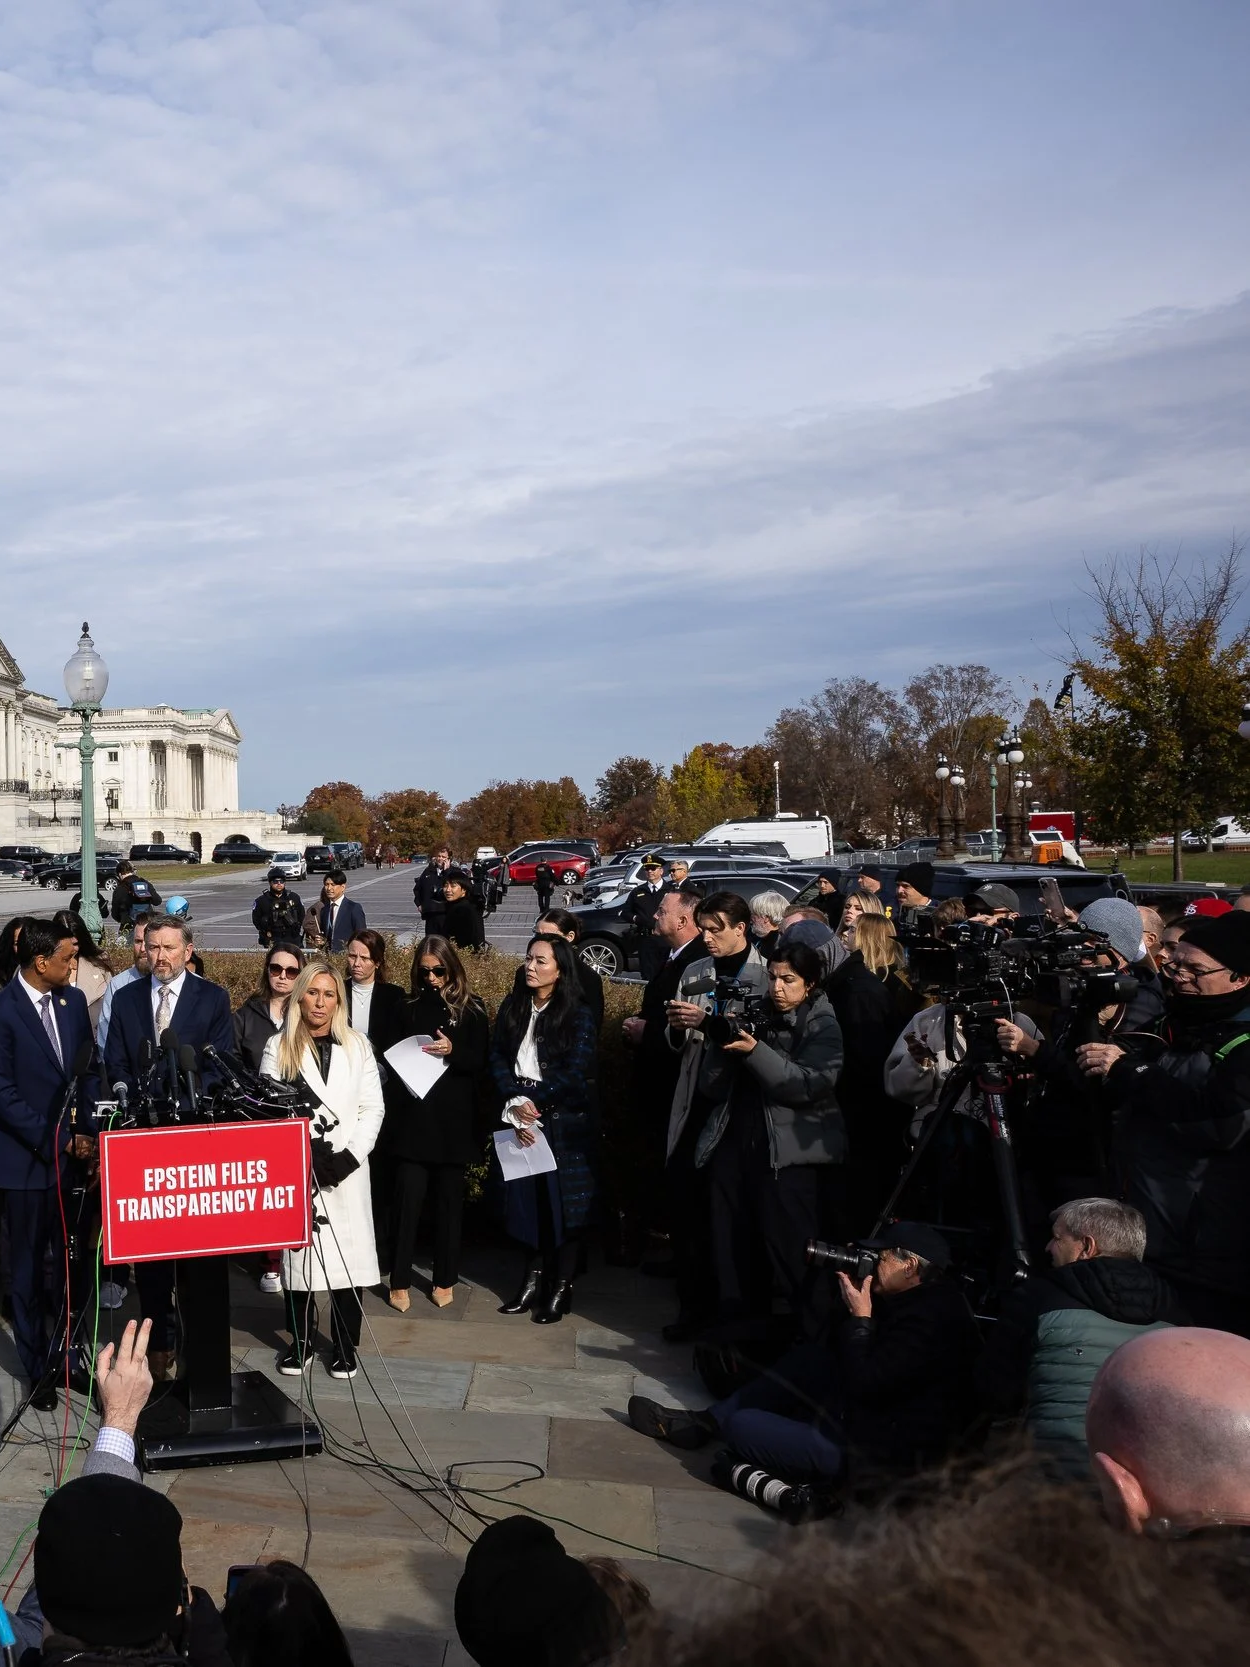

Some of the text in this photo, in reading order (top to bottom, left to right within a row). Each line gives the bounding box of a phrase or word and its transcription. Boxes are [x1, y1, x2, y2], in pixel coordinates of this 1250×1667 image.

[144, 1160, 268, 1192] EPSTEIN FILES
[116, 1185, 296, 1222] TRANSPARENCY ACT
